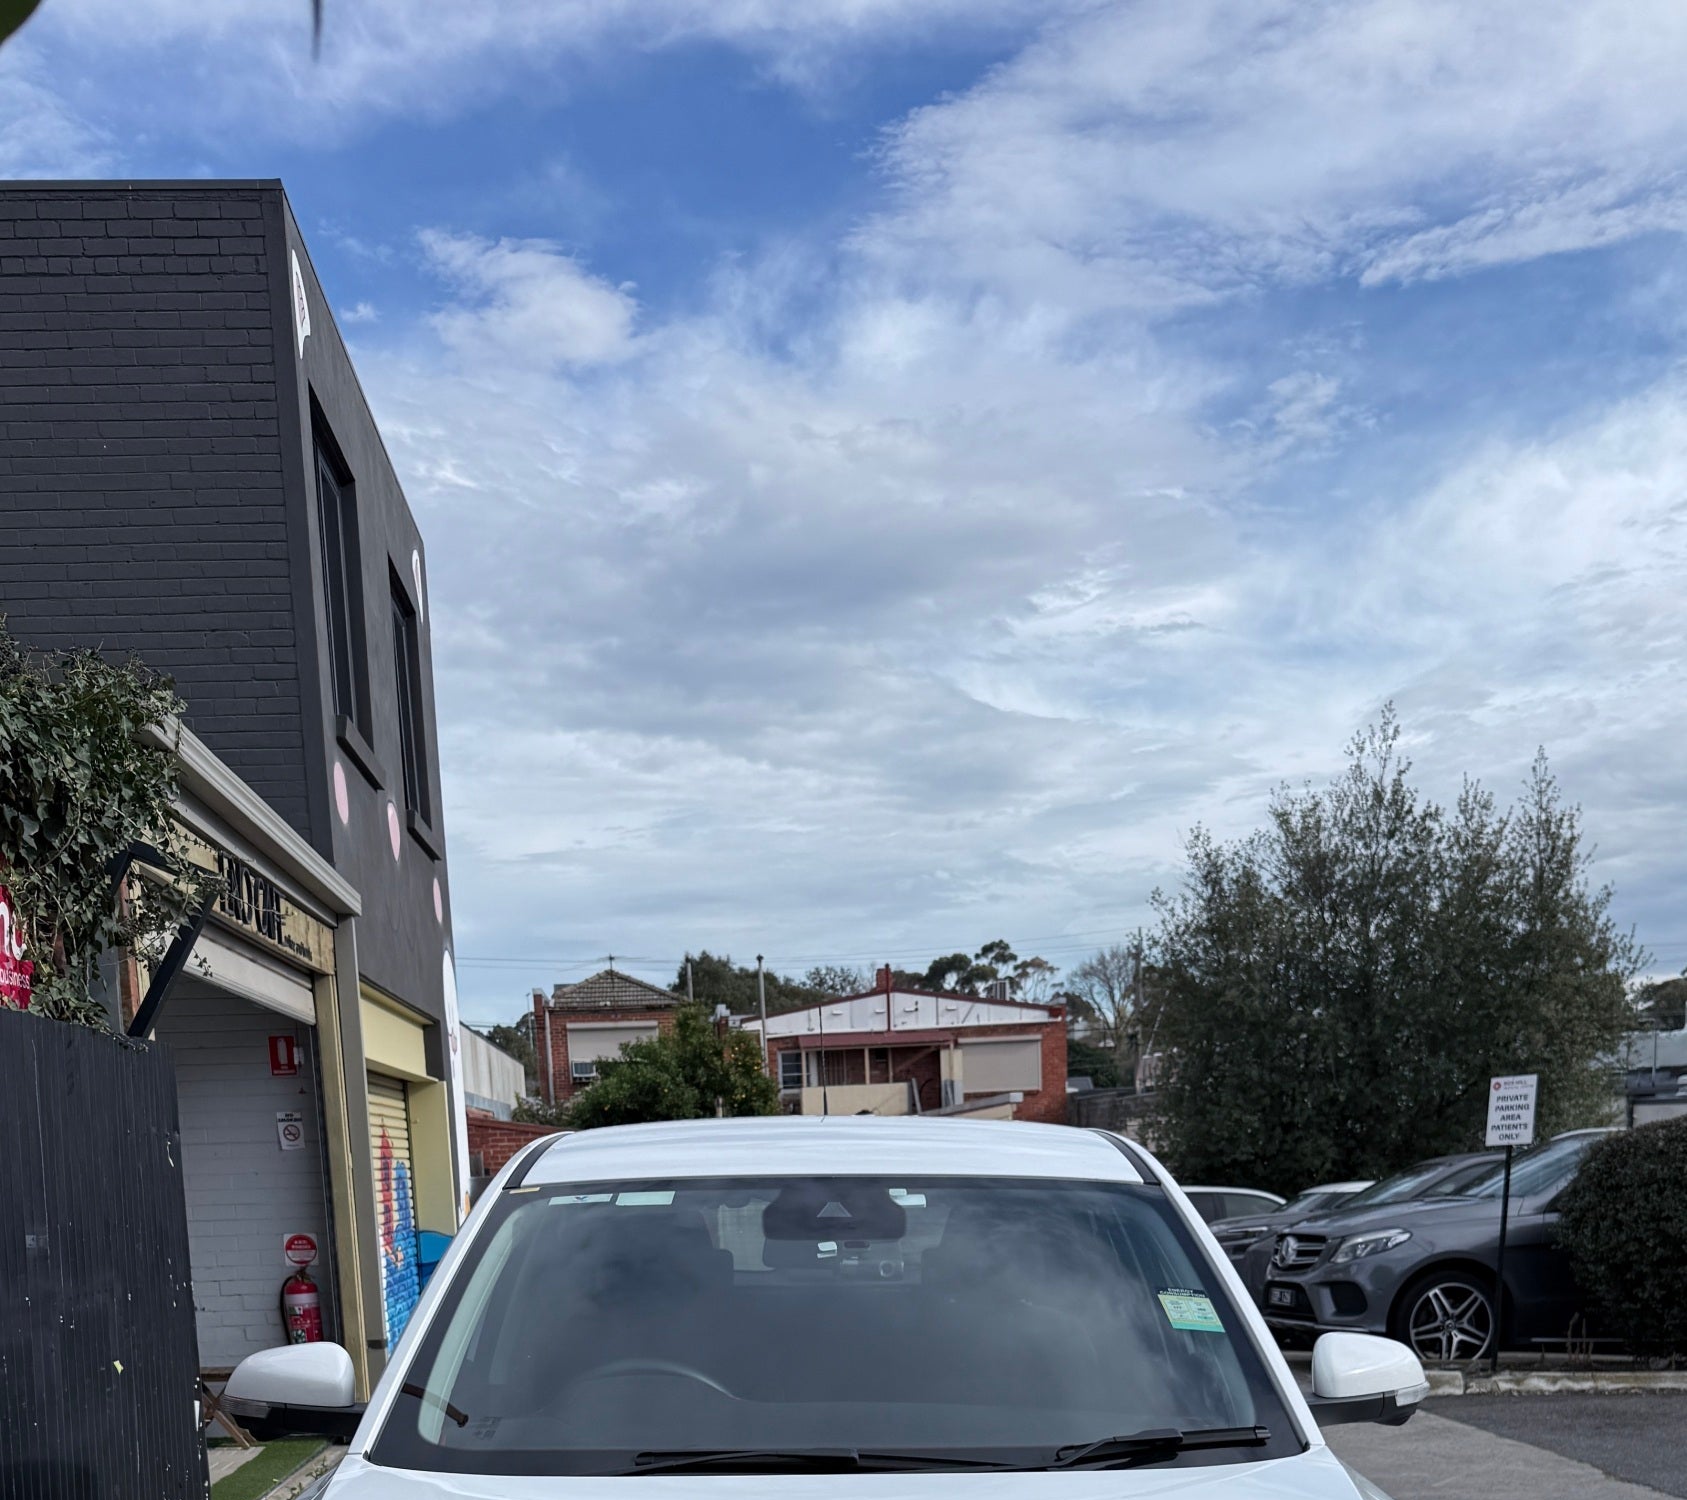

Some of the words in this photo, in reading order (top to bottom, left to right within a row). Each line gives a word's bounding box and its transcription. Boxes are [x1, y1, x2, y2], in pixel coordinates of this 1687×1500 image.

[1496, 1094, 1529, 1102] PRIVATE
[1495, 1103, 1530, 1112] PARKING
[1491, 1123, 1528, 1131] PATIENTS
[1498, 1132, 1520, 1141] ONLY
